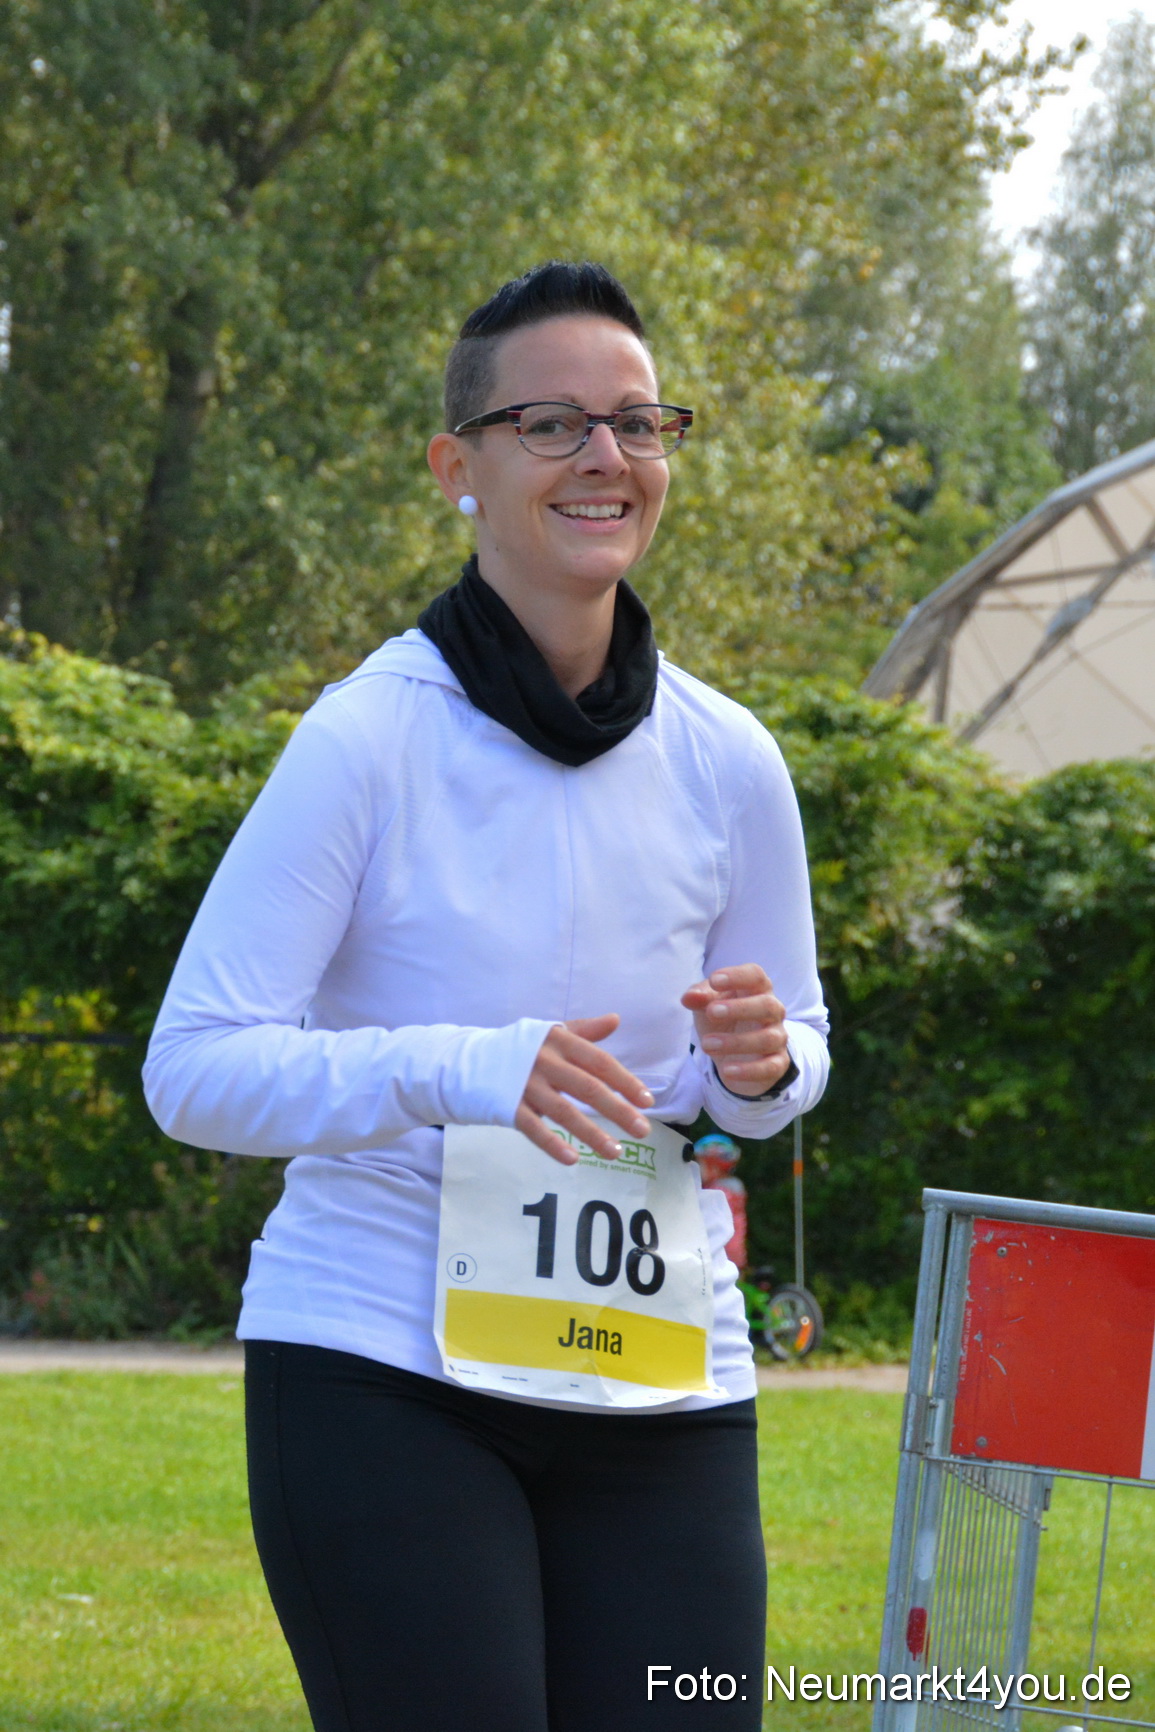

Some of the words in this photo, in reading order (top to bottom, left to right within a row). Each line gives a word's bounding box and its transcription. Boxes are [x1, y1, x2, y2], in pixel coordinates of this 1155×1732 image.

[522, 1192, 666, 1296] 108
[456, 1261, 467, 1276] D
[558, 1318, 622, 1356] Jana
